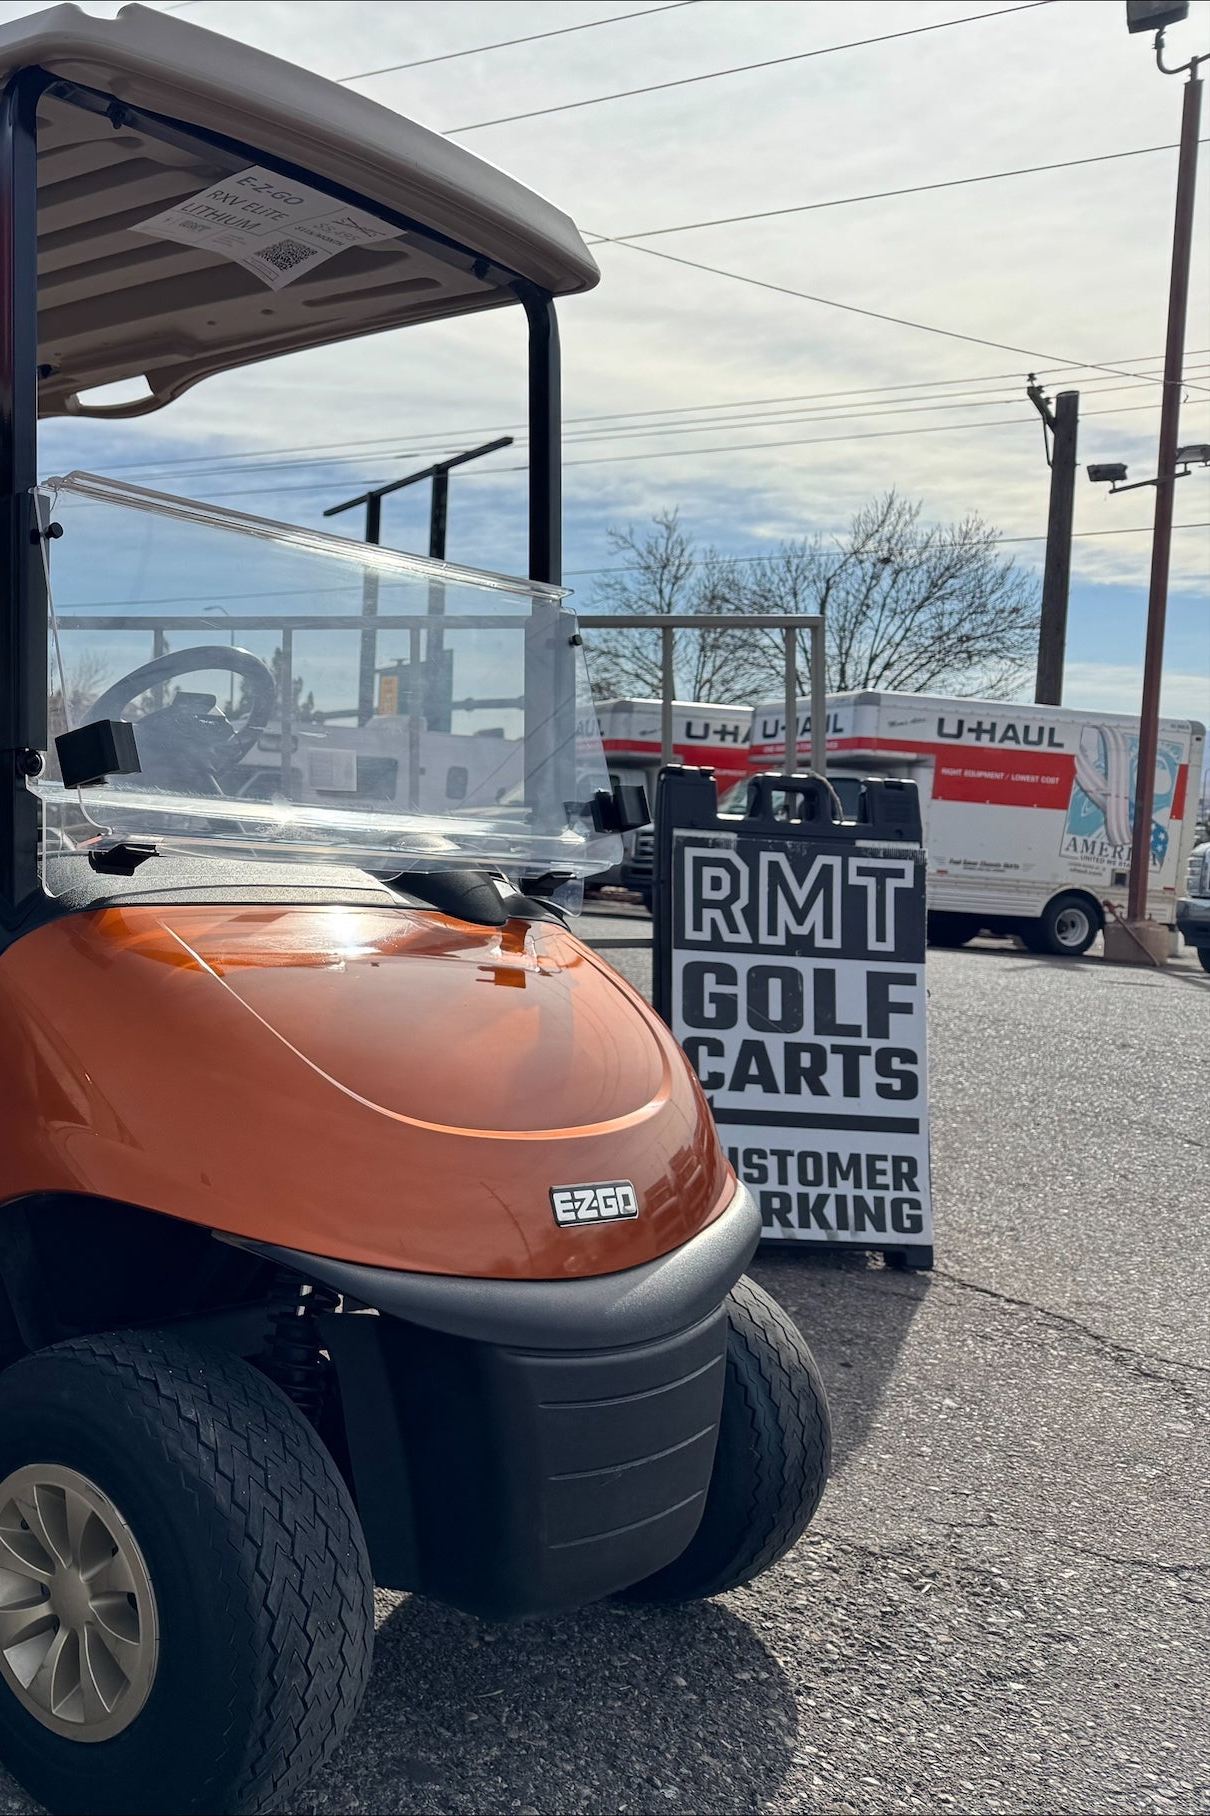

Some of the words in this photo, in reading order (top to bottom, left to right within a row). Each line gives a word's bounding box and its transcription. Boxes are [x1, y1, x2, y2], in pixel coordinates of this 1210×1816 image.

[206, 189, 248, 206] RXV
[236, 176, 304, 205] E-Z-GO
[181, 202, 262, 231] LITHIUM
[685, 720, 751, 744] U-H
[762, 713, 844, 739] U-AL
[937, 717, 1065, 748] U-HAUL
[941, 767, 962, 776] RIGHT
[964, 769, 1004, 780] EQUIPMENT
[1011, 773, 1039, 783] LOWEST
[1041, 775, 1060, 784] COST
[1065, 836, 1157, 866] AMERI
[1118, 860, 1130, 868] STA
[683, 846, 915, 952] RMT
[682, 961, 917, 1039] GOLF
[682, 1036, 919, 1100] CARTS
[728, 1147, 919, 1192] STOMER
[759, 1190, 923, 1234] RKING
